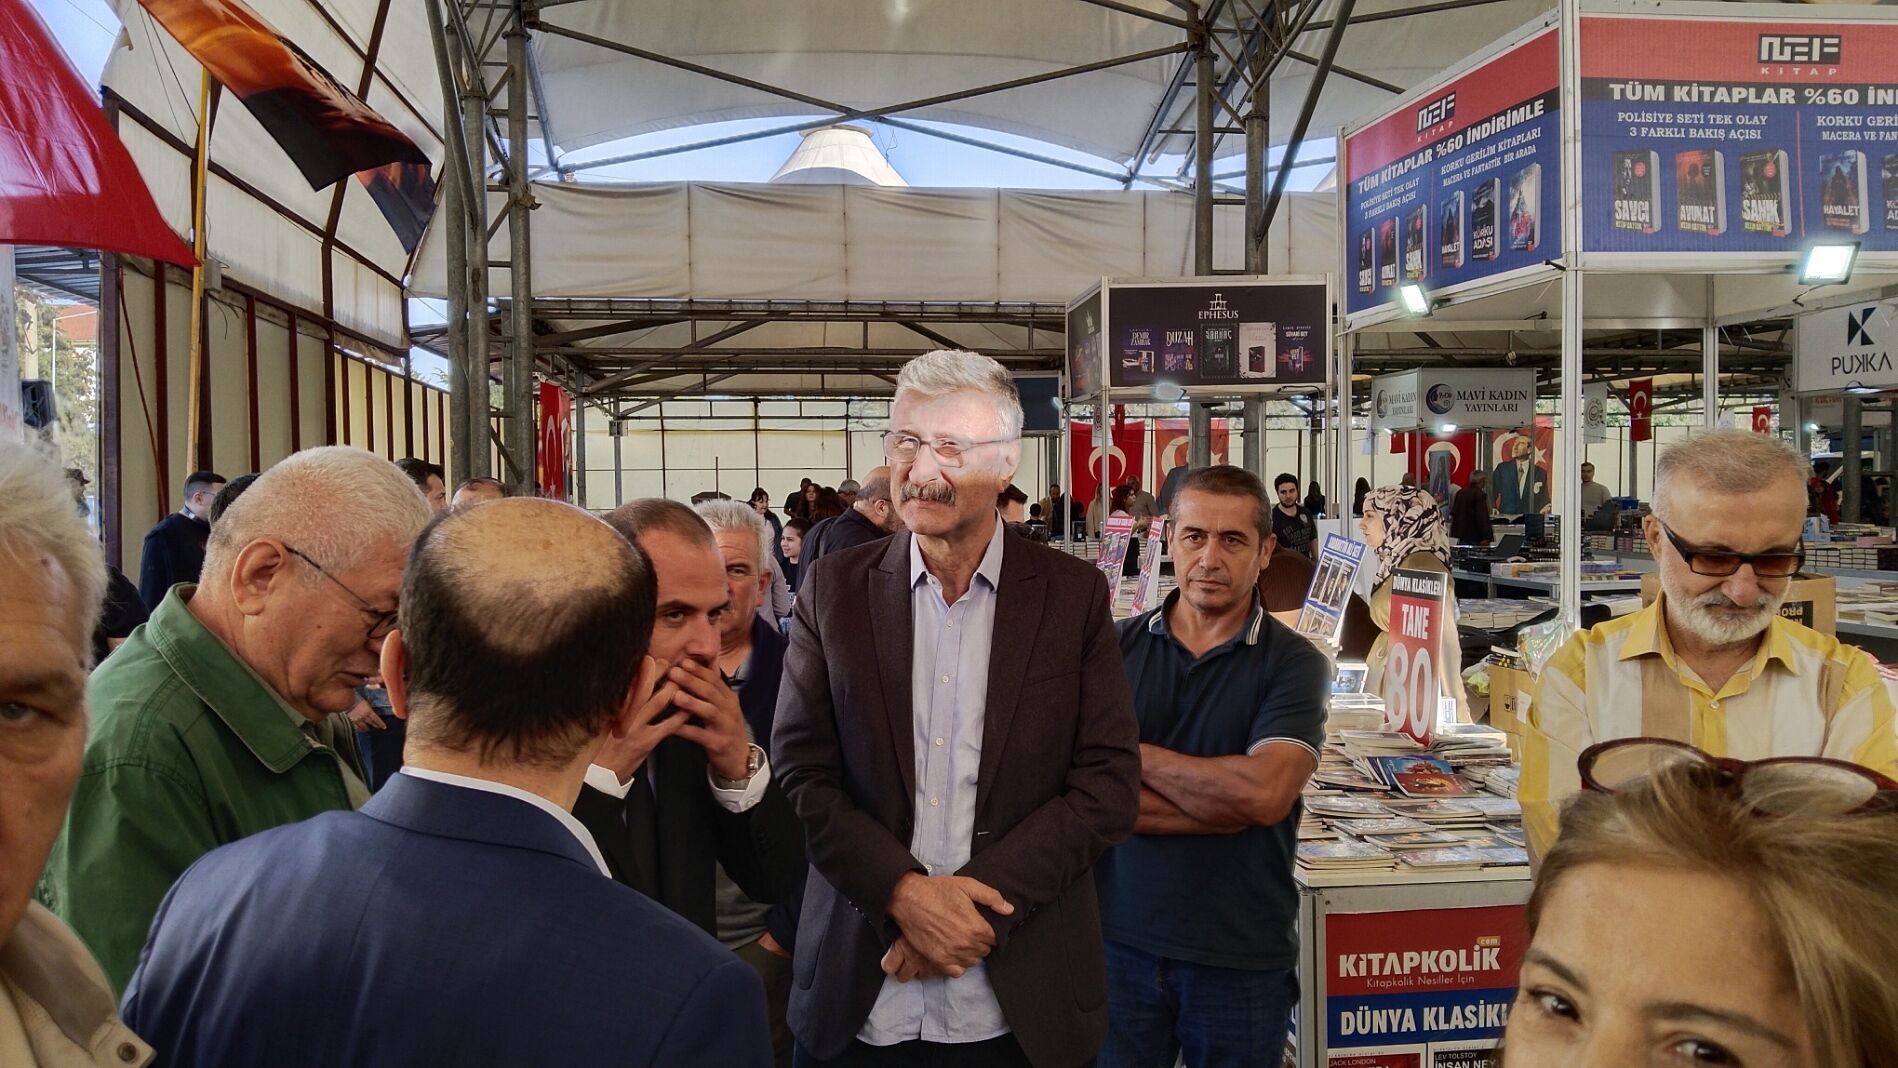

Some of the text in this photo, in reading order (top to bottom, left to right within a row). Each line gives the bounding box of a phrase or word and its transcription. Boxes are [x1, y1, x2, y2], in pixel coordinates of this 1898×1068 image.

[1608, 81, 1898, 105] TÜM KİTAPLAR %60 İN
[1617, 110, 1769, 125] POLİSİYE SETİ TEK OLAY
[1816, 115, 1863, 126] KORKU
[1629, 127, 1762, 141] 3 FARKLI BAKIŞ AÇISI
[1822, 131, 1862, 141] MACERA
[1863, 131, 1878, 141] VE
[1358, 98, 1545, 194] TÜM KİTAPLAR %60 İNDİRİMLE
[1440, 126, 1542, 175] KORKU GERİLİM KİTAPLARI
[1442, 172, 1463, 188] MACERA
[1471, 156, 1502, 176] FANTASTİK
[1504, 150, 1515, 164] BİR
[1515, 144, 1537, 160] ARADA
[1405, 176, 1420, 191] OLAY
[1614, 200, 1650, 223] SAVCI
[1823, 204, 1860, 216] HAYALET
[1473, 236, 1494, 250] ADASI
[1198, 310, 1240, 320] EPHESUS
[1456, 386, 1486, 401] MAVİ
[1488, 390, 1528, 401] KADIN
[1465, 403, 1518, 412] YAYINLARI
[1392, 573, 1411, 592] DÜNYA
[1401, 603, 1430, 641] TANE
[1386, 642, 1432, 738] 80
[1480, 937, 1498, 945] com
[1366, 972, 1475, 989] Kitapkolik Nesiller İçin
[1340, 1005, 1417, 1036] DÜNYA
[1329, 1058, 1376, 1067] JACK LONDON
[1435, 1051, 1478, 1061] LEV TOLSTOY
